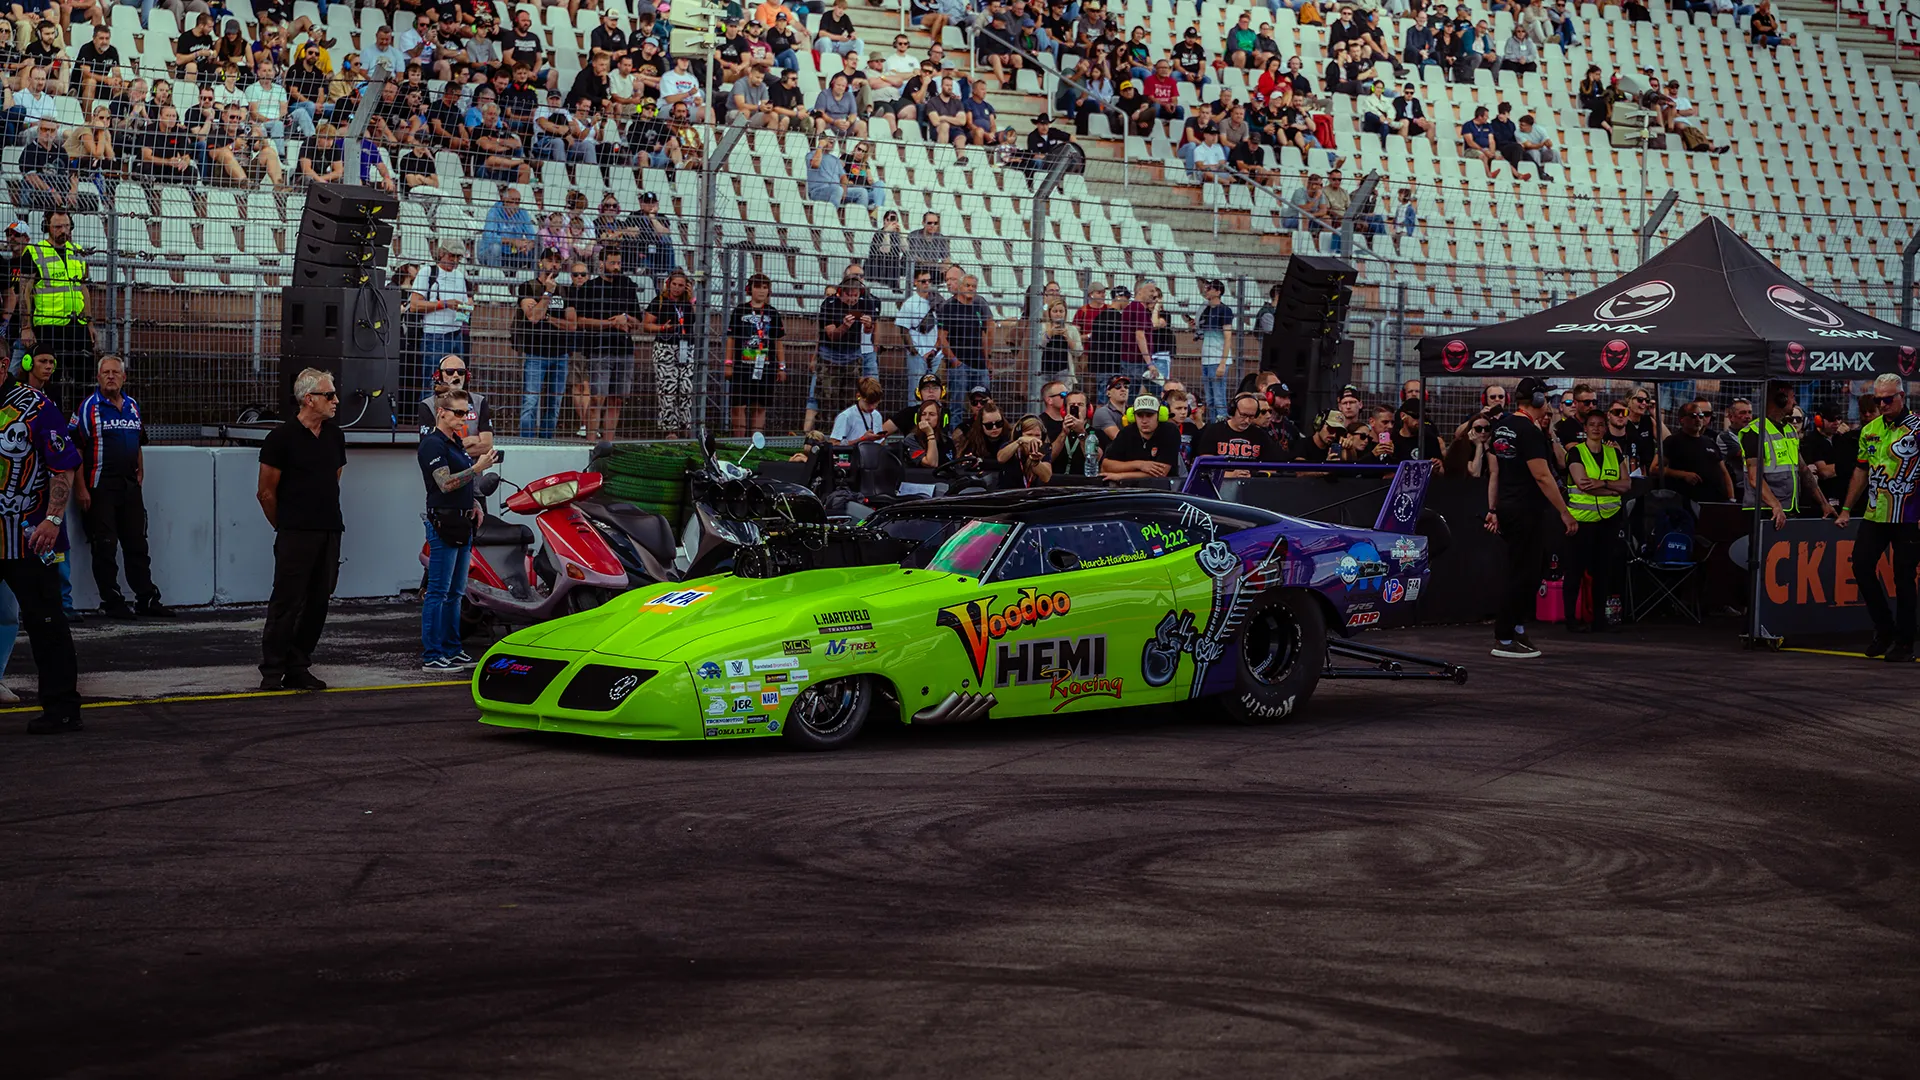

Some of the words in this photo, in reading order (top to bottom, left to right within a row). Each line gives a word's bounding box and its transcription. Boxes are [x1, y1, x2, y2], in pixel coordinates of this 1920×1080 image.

[1546, 322, 1657, 334] 24MX
[1807, 327, 1894, 341] 24MX
[1472, 350, 1566, 371] 24MX
[1633, 349, 1736, 375] 24MX
[1808, 350, 1876, 372] 24MX
[1136, 397, 1156, 408] BOSTON
[103, 418, 142, 428] LUCAS
[1141, 523, 1164, 541] PM
[1162, 529, 1189, 549] 222
[1384, 578, 1400, 602] VP
[813, 609, 871, 626] L.HARTEVELD
[1348, 612, 1380, 626] ARP
[828, 624, 864, 634] TRANSPORT
[935, 586, 1071, 688] Voodoo
[783, 640, 811, 650] MCN
[993, 633, 1107, 689] HEMI
[1040, 666, 1124, 701] Racing
[731, 699, 753, 713] JER
[762, 692, 779, 705] NAPA
[1240, 692, 1297, 720] Hoosier
[718, 728, 736, 736] OMA
[736, 727, 757, 735] LENY
